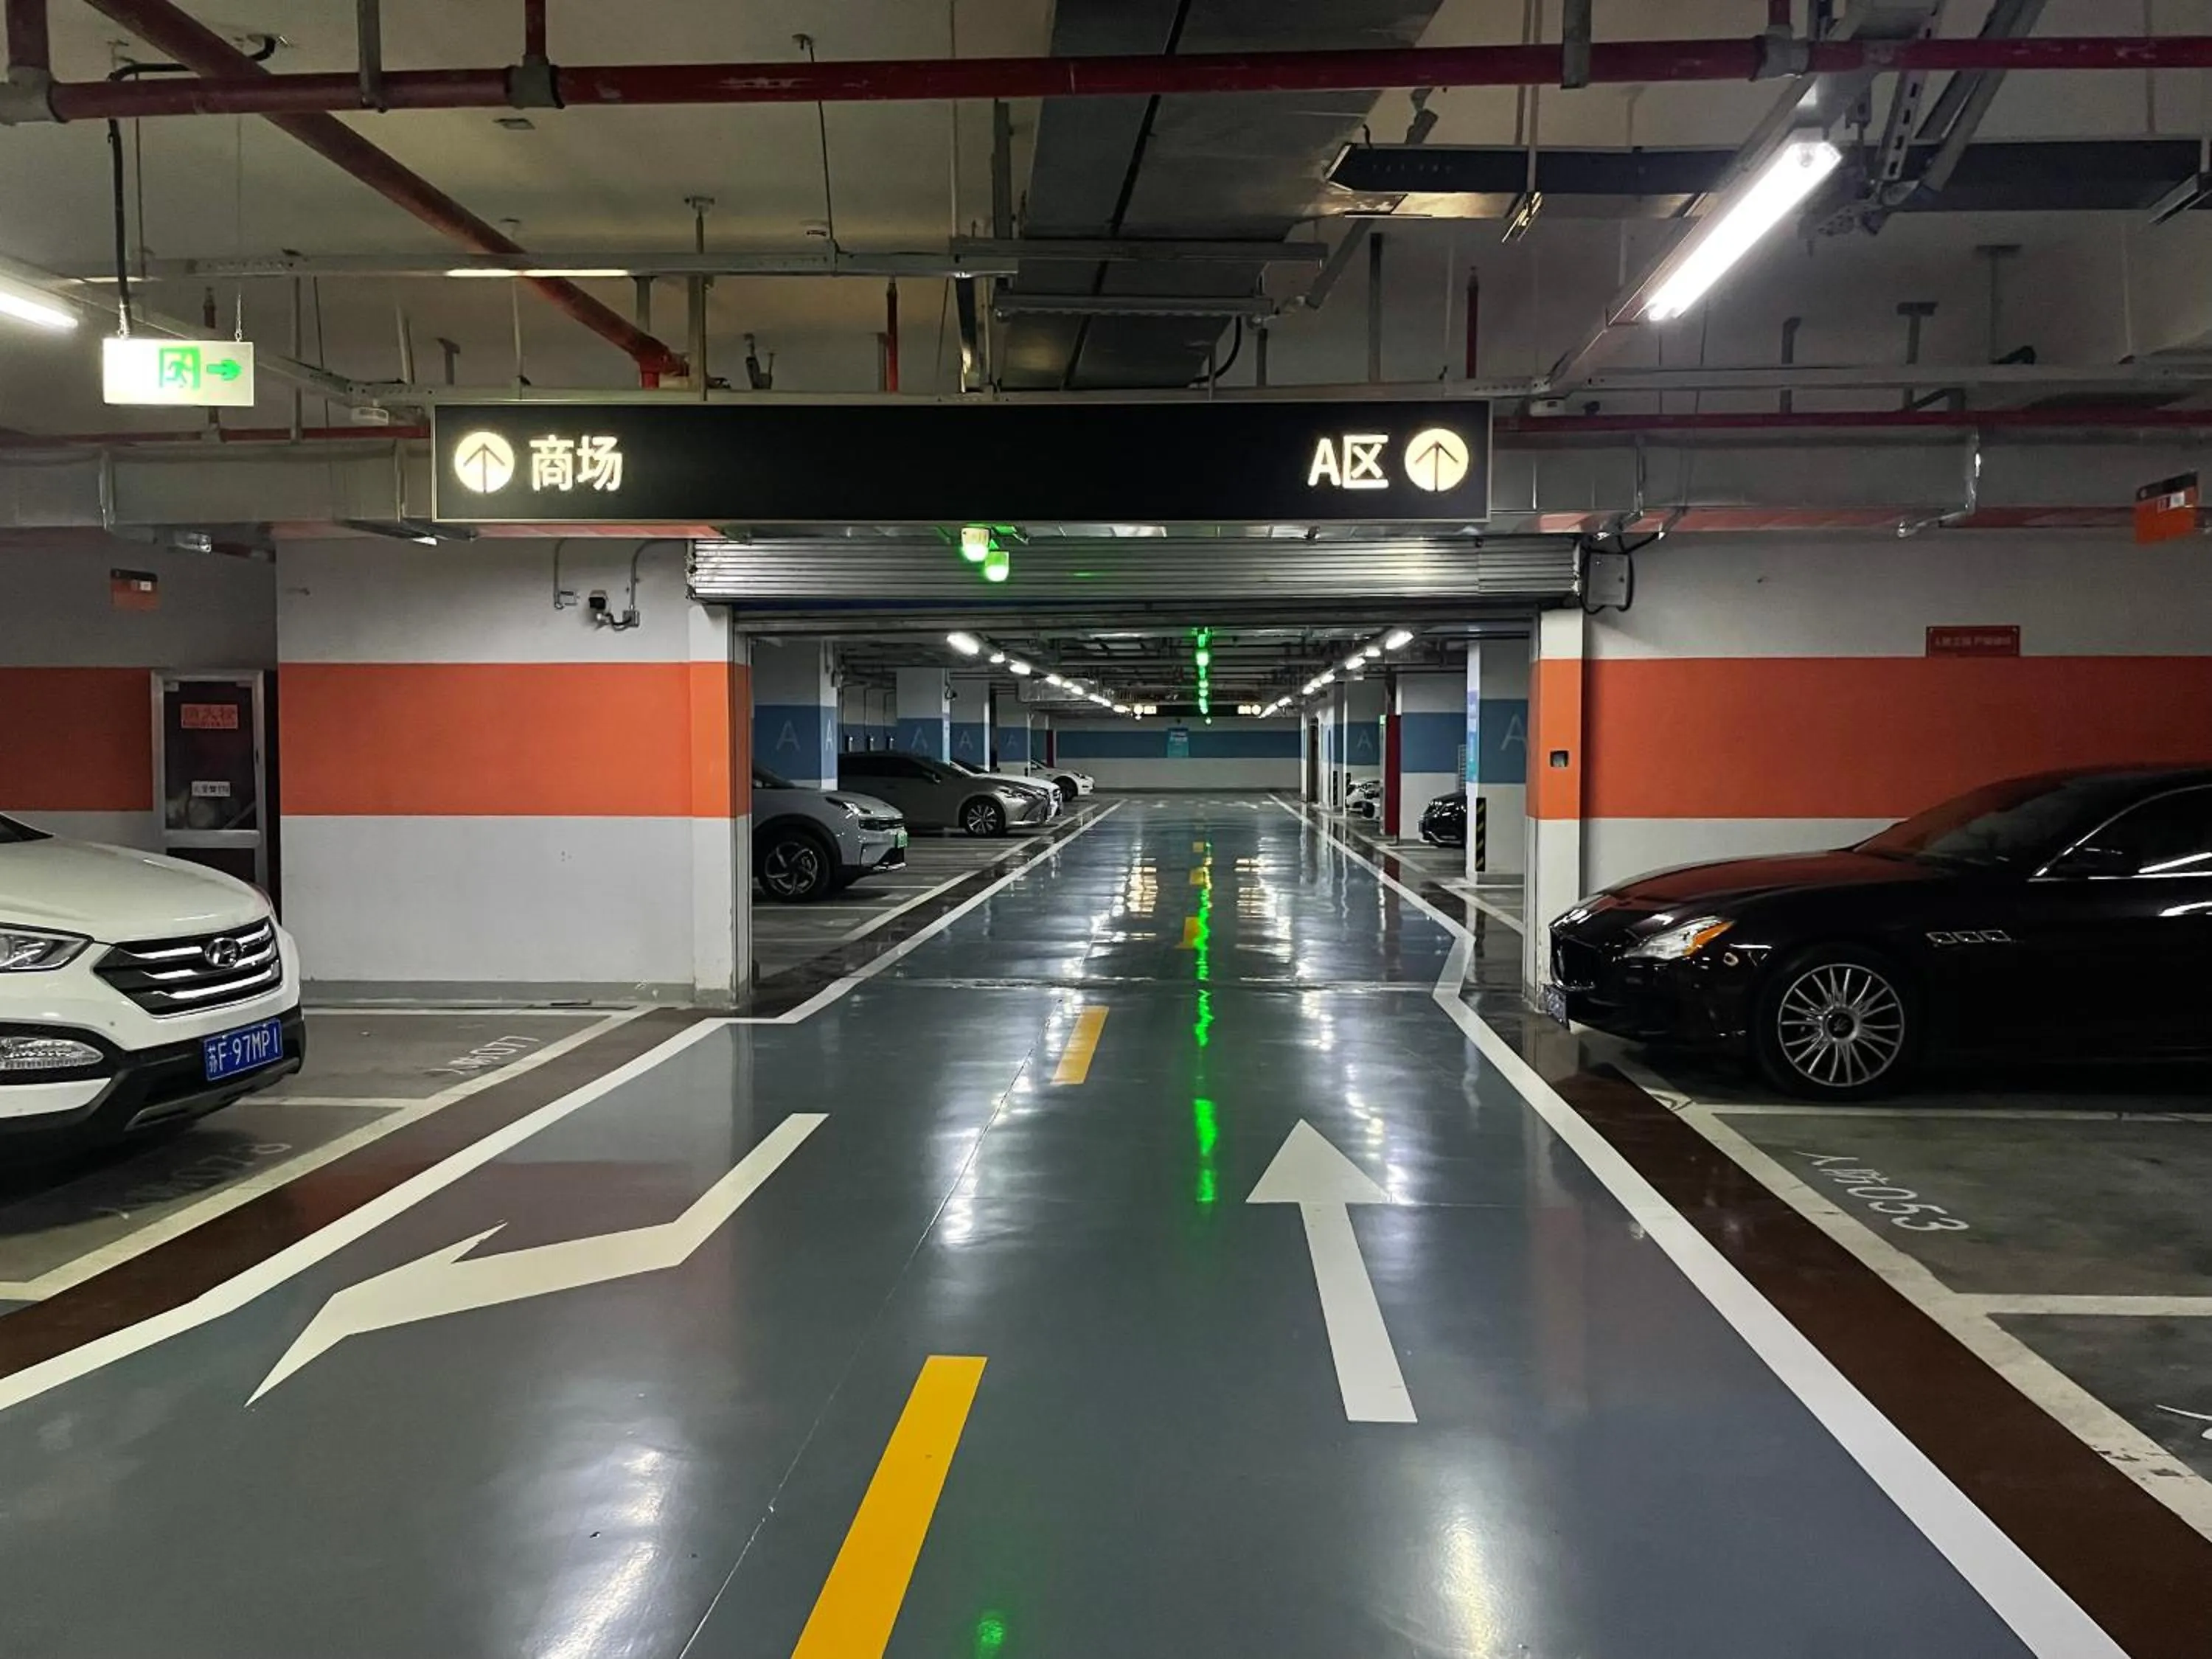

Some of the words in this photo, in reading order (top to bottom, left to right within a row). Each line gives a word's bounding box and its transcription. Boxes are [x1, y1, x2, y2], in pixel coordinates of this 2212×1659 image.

[529, 434, 624, 492] 商场
[1307, 434, 1390, 489] A区
[776, 720, 801, 751] A
[825, 719, 834, 751] A
[959, 730, 973, 751] A
[1356, 729, 1373, 750] A
[1500, 713, 1527, 751] A
